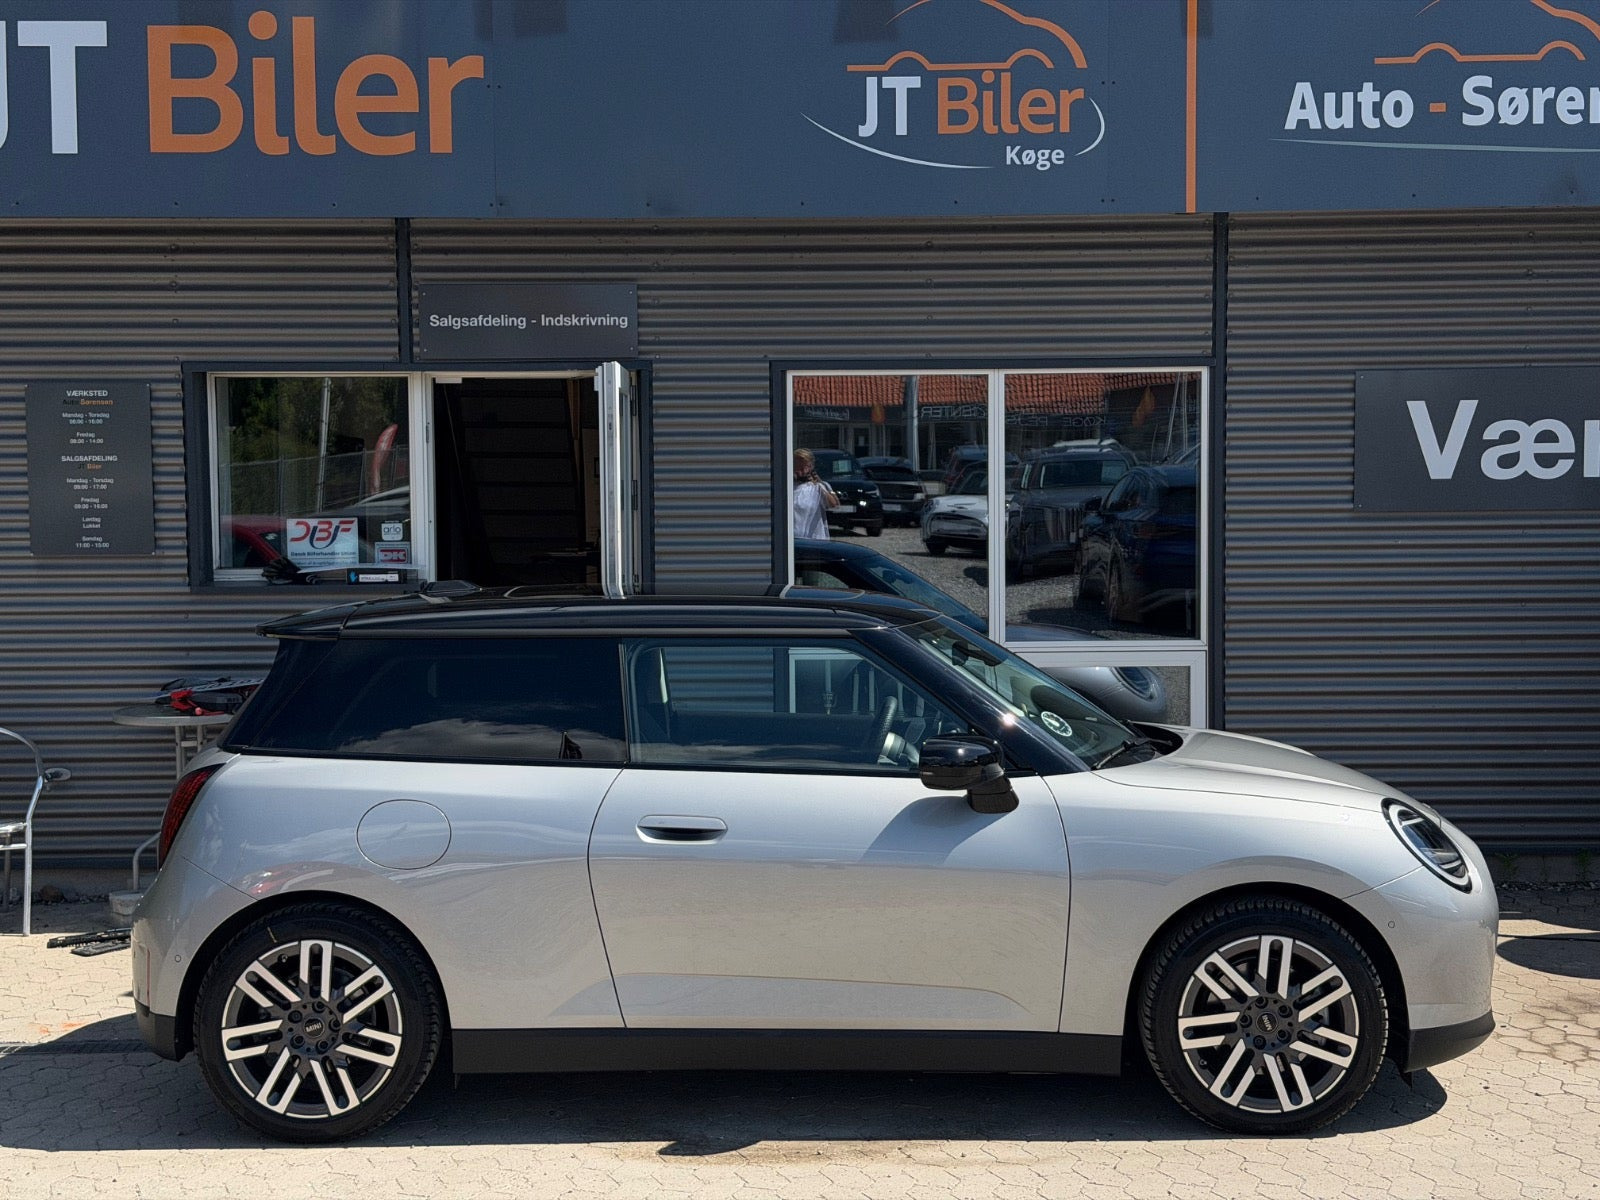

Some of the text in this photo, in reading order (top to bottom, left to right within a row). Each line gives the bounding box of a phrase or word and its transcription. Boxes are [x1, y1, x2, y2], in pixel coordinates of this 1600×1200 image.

[146, 10, 485, 156] Biler
[858, 69, 1085, 137] JT Biler
[1284, 81, 1414, 130] Auto
[1005, 145, 1065, 171] Køge
[429, 314, 527, 330] Salgsafdeling
[541, 313, 629, 329] Indskrivning
[305, 1021, 322, 1033] MINI
